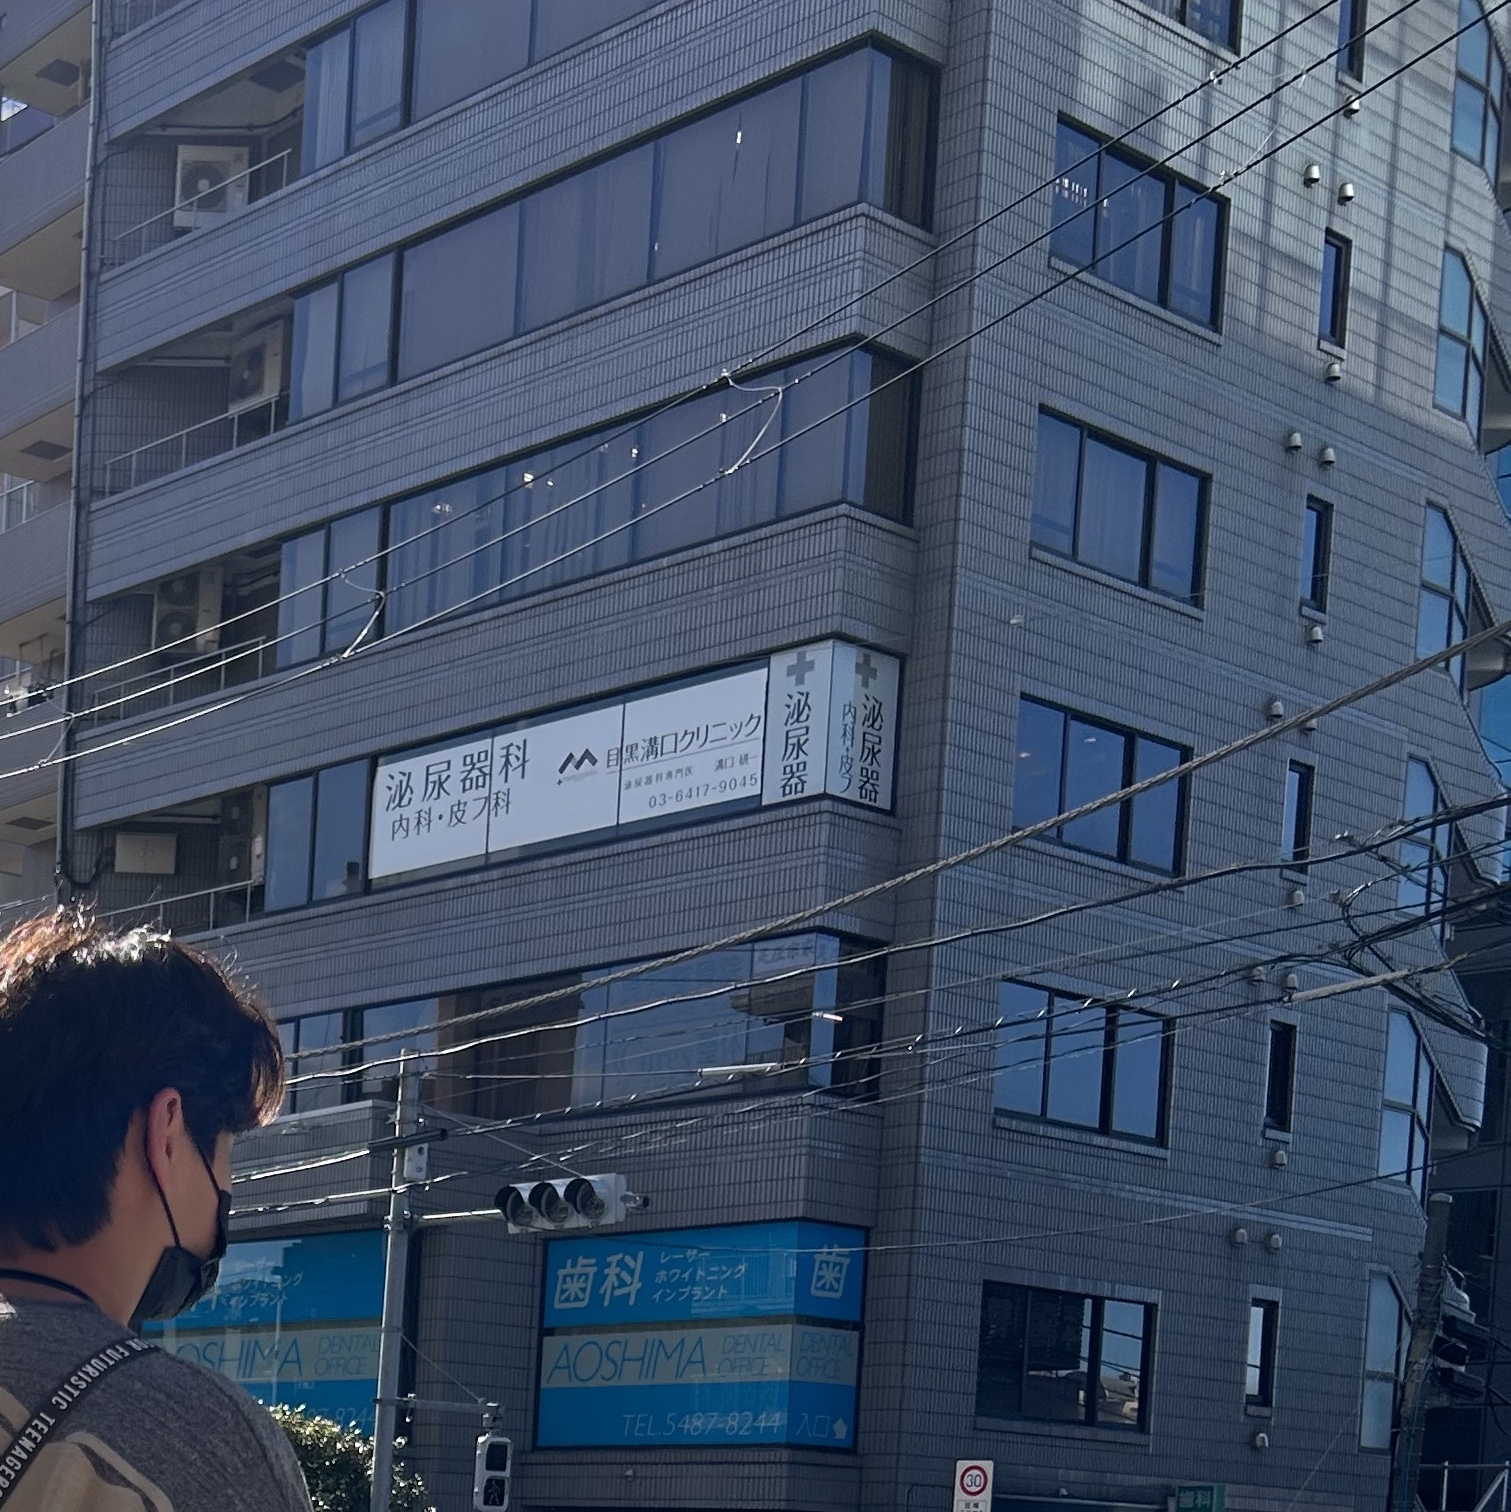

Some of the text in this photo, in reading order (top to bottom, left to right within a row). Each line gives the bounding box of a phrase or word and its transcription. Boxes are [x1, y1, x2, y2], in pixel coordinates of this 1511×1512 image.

[606, 712, 762, 768] 目黒溝口クリニック
[780, 691, 811, 797] 泌尿器
[858, 693, 884, 803] 泌尿器
[385, 738, 531, 812] 泌尿器科
[648, 773, 758, 808] 03-6417-9045
[391, 787, 511, 841] 内科・皮フ科
[661, 1249, 711, 1264] レーザー
[810, 1243, 851, 1299] 歯
[552, 1250, 644, 1309] 歯科
[654, 1262, 748, 1284] ホワイトニング
[652, 1284, 728, 1303] インプラント
[723, 1333, 784, 1354] DENTAL
[801, 1331, 856, 1357] DENTAL
[314, 1356, 368, 1377] OFFICE
[547, 1336, 707, 1384] AOSHIMA
[717, 1357, 769, 1378] OFFICE
[796, 1355, 841, 1379] OFFICE
[51, 1344, 130, 1410] FUTURISTIC
[796, 1412, 830, 1438] 入口
[966, 1473, 982, 1488] 30
